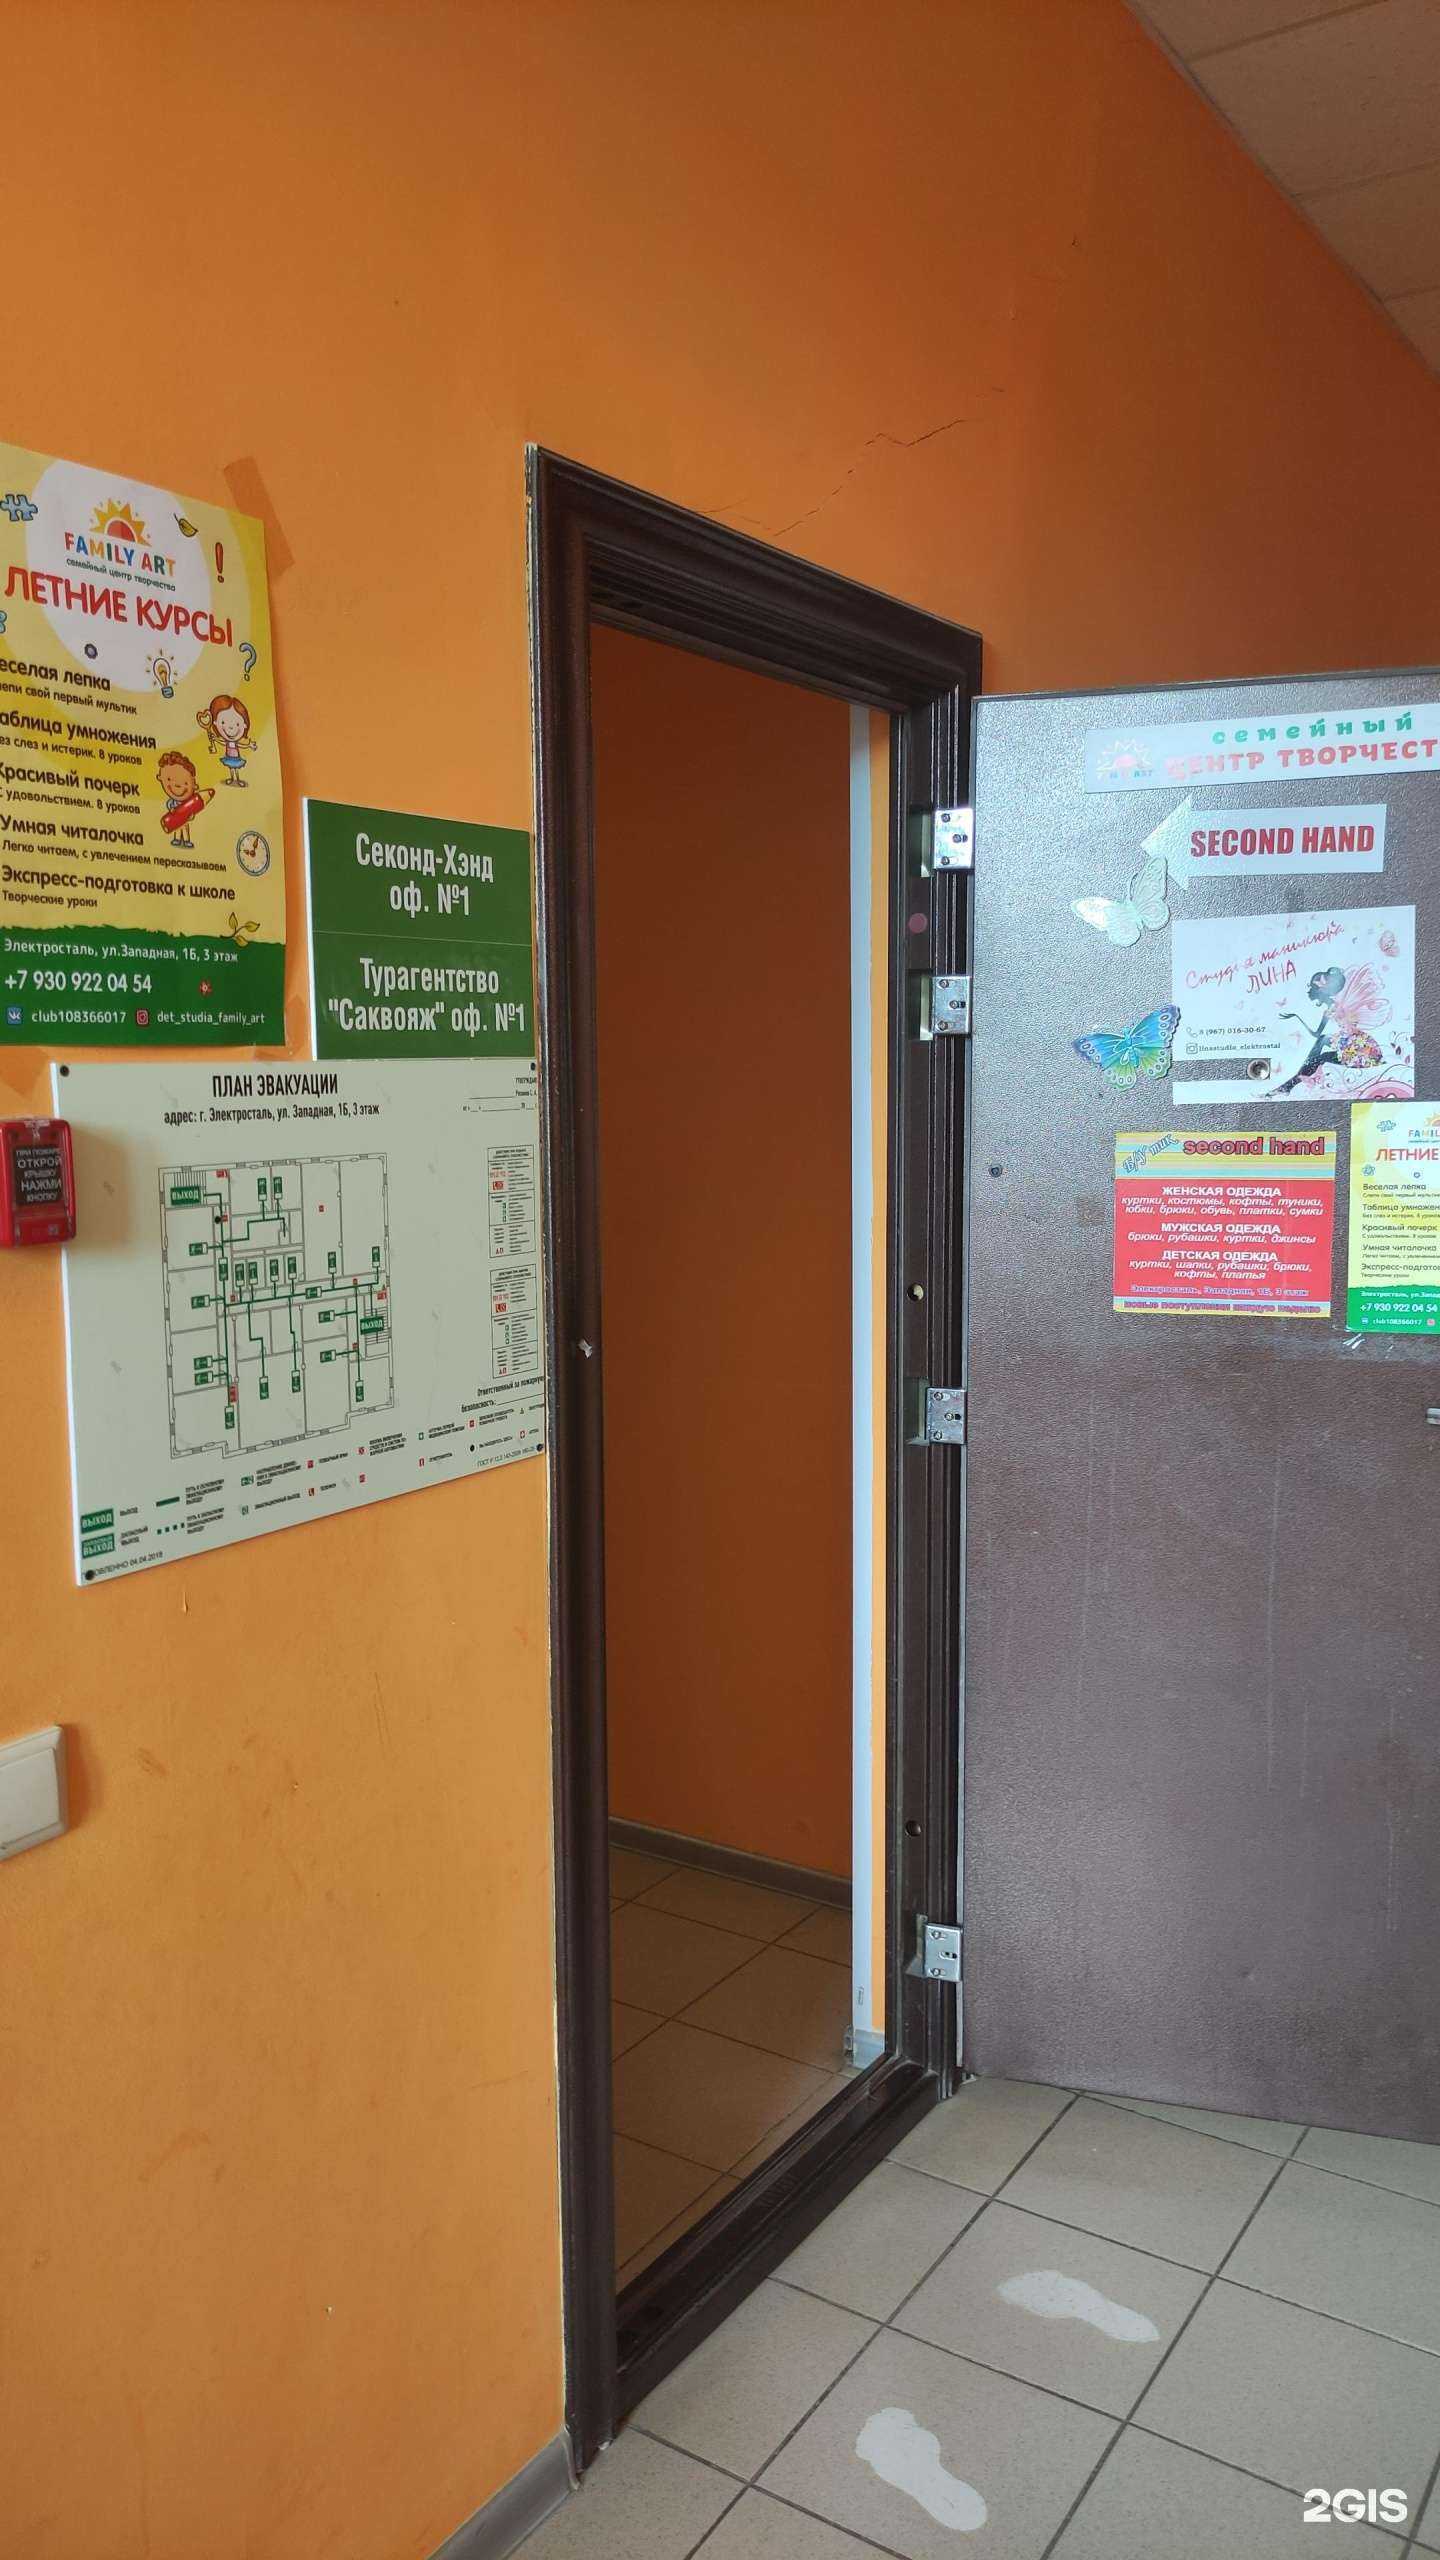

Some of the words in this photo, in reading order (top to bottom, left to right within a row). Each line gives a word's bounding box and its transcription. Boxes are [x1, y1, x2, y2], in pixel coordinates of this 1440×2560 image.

[65, 532, 134, 566] FAMILY
[141, 552, 176, 577] ART
[109, 569, 132, 581] центр
[5, 566, 128, 623] ЛЕТНИЕ
[136, 596, 233, 647] КУРСЫ
[63, 671, 111, 691] лепка
[0, 683, 22, 694] епи
[25, 687, 50, 699] свой
[53, 690, 93, 705] первый
[96, 700, 137, 715] мультик
[67, 722, 157, 749] умножения
[14, 738, 38, 749] слез
[42, 742, 48, 751] и
[52, 744, 96, 758] истерик.
[99, 749, 104, 759] 8
[108, 752, 142, 765] уроков
[84, 777, 140, 798] почерк
[6, 789, 94, 808] удовольствием.
[97, 799, 103, 809] 8
[106, 803, 140, 814] уроков
[1, 814, 56, 836] Умная
[61, 824, 144, 846] читалочка
[1191, 828, 1294, 857] SECOND
[1302, 825, 1375, 853] HAND
[3, 839, 35, 852] Легко
[37, 842, 79, 859] читаем,
[82, 849, 88, 858] с
[90, 850, 151, 865] увлечением
[153, 857, 227, 872] пересказываем
[356, 833, 494, 883] Секонд-Хэнд
[2, 865, 173, 895] Экспресс-подготовка
[177, 885, 185, 896] к
[190, 885, 235, 900] школе
[2, 890, 64, 906] Творческие
[67, 896, 98, 908] уроки
[390, 881, 429, 918] оф.
[438, 884, 469, 915] №1
[4, 938, 98, 957] Электросталь,
[203, 948, 210, 961] 3
[213, 952, 239, 962] этаж
[5, 970, 28, 990] +7
[33, 971, 66, 991] 930
[71, 972, 103, 992] 922
[107, 973, 128, 993] 04
[133, 974, 152, 993] 54
[359, 957, 499, 997] Турагентство
[31, 1010, 127, 1023] club108366017
[157, 1010, 265, 1026] det_studia_family_art
[329, 998, 445, 1031] "Саквояж"
[451, 1002, 488, 1037] оф.
[495, 1003, 525, 1032] №1
[212, 1075, 252, 1097] ПЛАН
[257, 1074, 338, 1098] ЭВАКУАЦИИ
[164, 1110, 197, 1126] адрес:
[200, 1111, 207, 1122] г.
[209, 1107, 275, 1124] Электросталь,
[277, 1109, 290, 1121] ул.
[292, 1104, 336, 1120] Западная,
[353, 1102, 358, 1116] 3
[360, 1104, 380, 1115] этаж
[1183, 1136, 1263, 1155] second
[1269, 1136, 1325, 1156] hand
[1376, 1148, 1439, 1161] ЛЕТНИЕ
[17, 1155, 62, 1168] ОТКРОЙ
[21, 1178, 61, 1192] НАЖМИ
[172, 1189, 199, 1200] ВЫХОД
[1162, 1186, 1224, 1196] ЖЕНСКАЯ
[1226, 1187, 1282, 1197] ОДЕЖДА
[1121, 1197, 1164, 1206] куртки,
[1168, 1198, 1225, 1207] костюмы,
[1159, 1205, 1197, 1215] брюки,
[1289, 1208, 1324, 1217] сумки
[1127, 1232, 1165, 1242] брюки,
[1168, 1233, 1220, 1243] рубашки,
[1223, 1235, 1267, 1244] куртки,
[1271, 1234, 1316, 1244] джинсы
[1161, 1223, 1223, 1232] МУЖСКАЯ
[1225, 1223, 1281, 1234] ОДЕЖДА
[1129, 1260, 1172, 1270] куртки,
[1273, 1262, 1312, 1272] брюки,
[1162, 1250, 1220, 1260] ДЕТСКАЯ
[1222, 1251, 1278, 1262] ОДЕЖДА
[1221, 1271, 1266, 1280] платья
[1374, 1303, 1391, 1311] 930
[1393, 1304, 1410, 1312] 922
[1412, 1304, 1424, 1312] 04
[1426, 1304, 1438, 1312] 54
[361, 1318, 383, 1330] ВЫХОД
[82, 1513, 112, 1528] ВЫХОД
